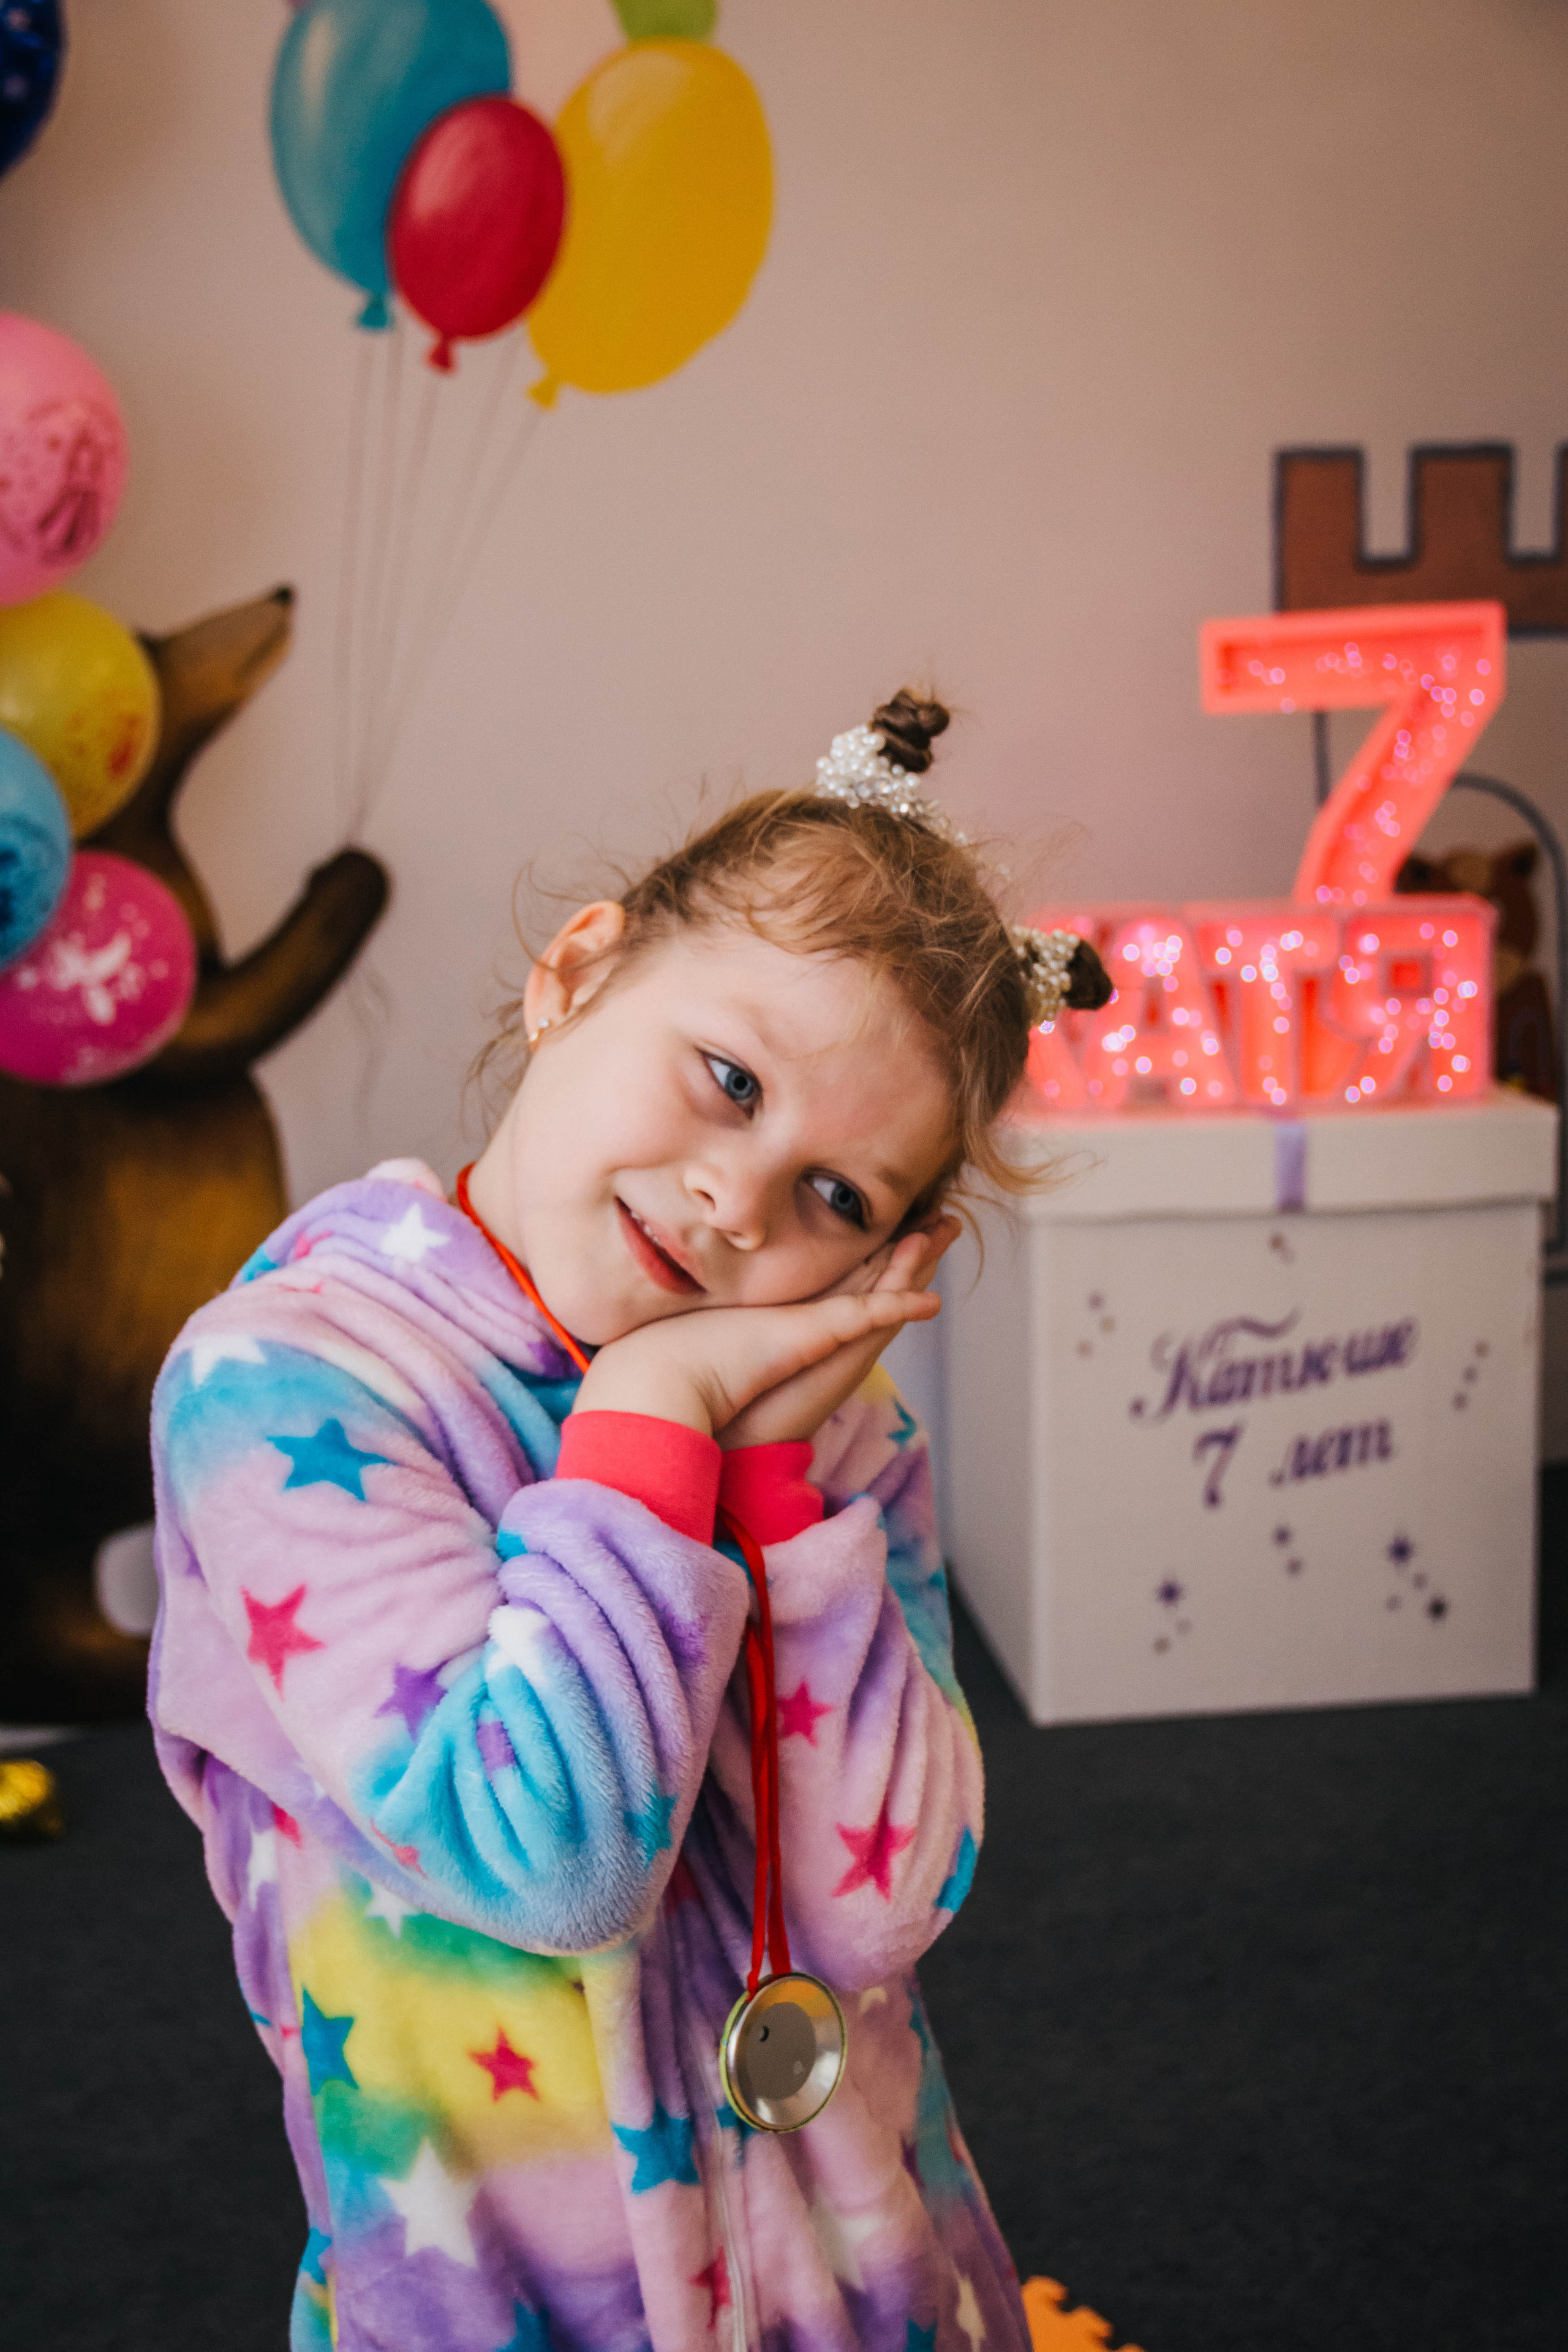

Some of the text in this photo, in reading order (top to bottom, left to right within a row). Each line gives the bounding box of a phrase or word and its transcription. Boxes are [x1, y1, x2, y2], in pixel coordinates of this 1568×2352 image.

[1199, 600, 1507, 905] 7
[1193, 1417, 1393, 1509] 7 лет
